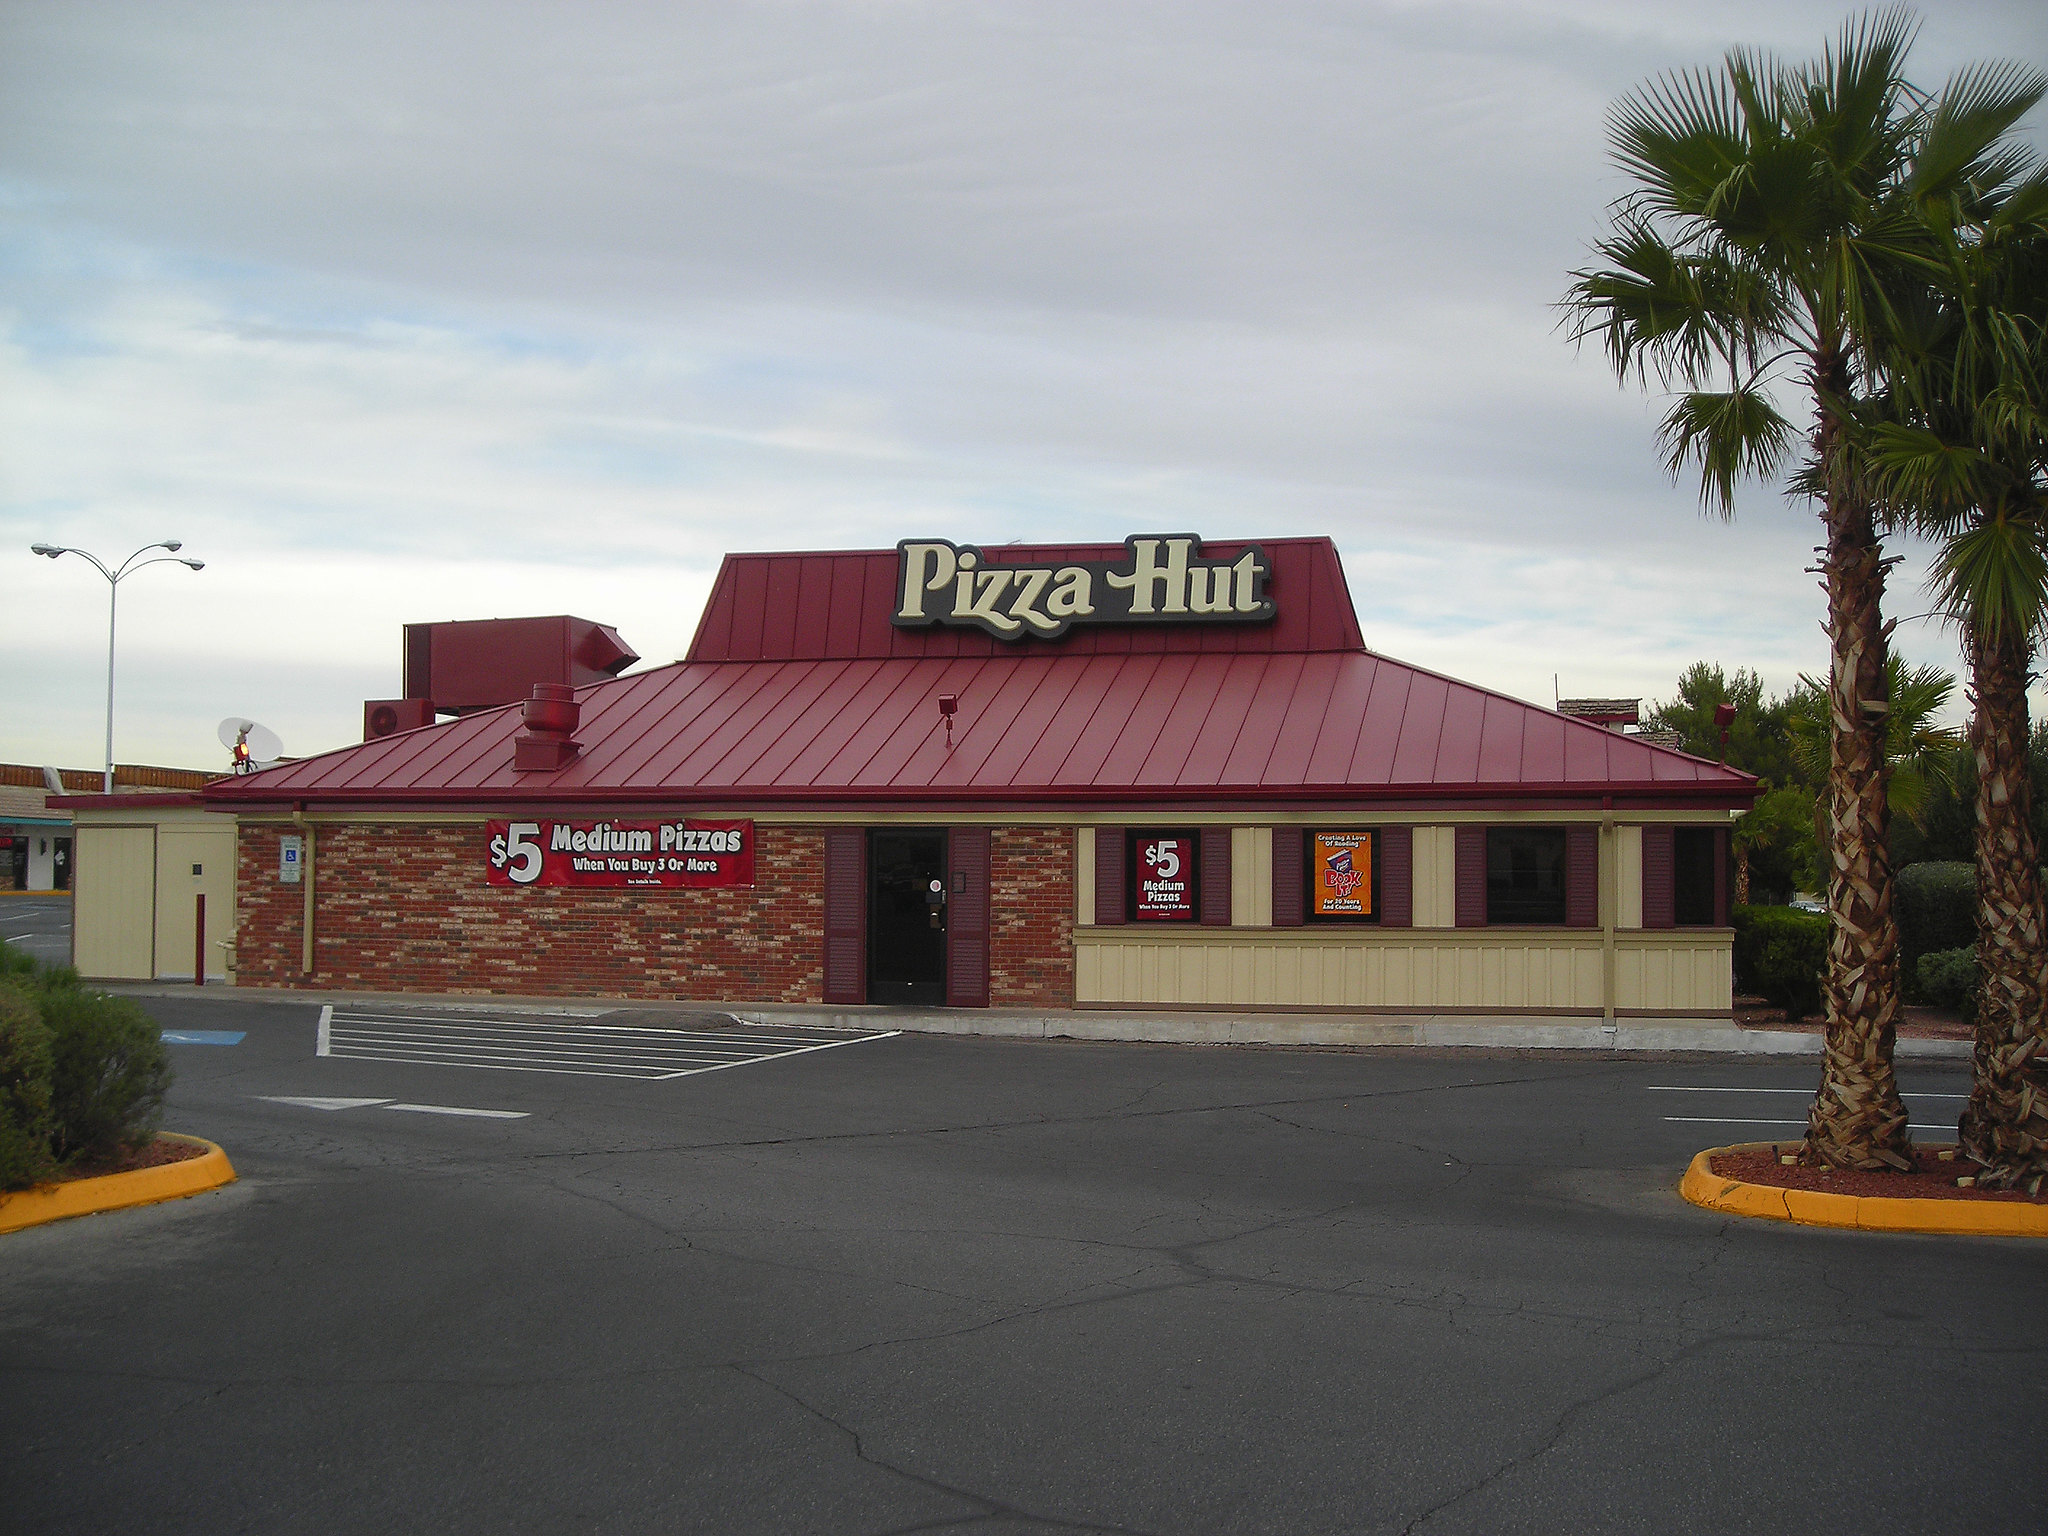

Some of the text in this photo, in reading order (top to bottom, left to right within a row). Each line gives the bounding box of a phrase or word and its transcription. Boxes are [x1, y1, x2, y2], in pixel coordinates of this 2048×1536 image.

[898, 539, 1265, 629] Pizza Hut
[550, 824, 741, 852] Medium Pizzas
[490, 823, 543, 883] $5
[572, 857, 717, 874] When You Buy 3 Or More
[1145, 841, 1180, 878] $5
[1143, 880, 1185, 891] Medium
[1147, 892, 1181, 902] Pizzas
